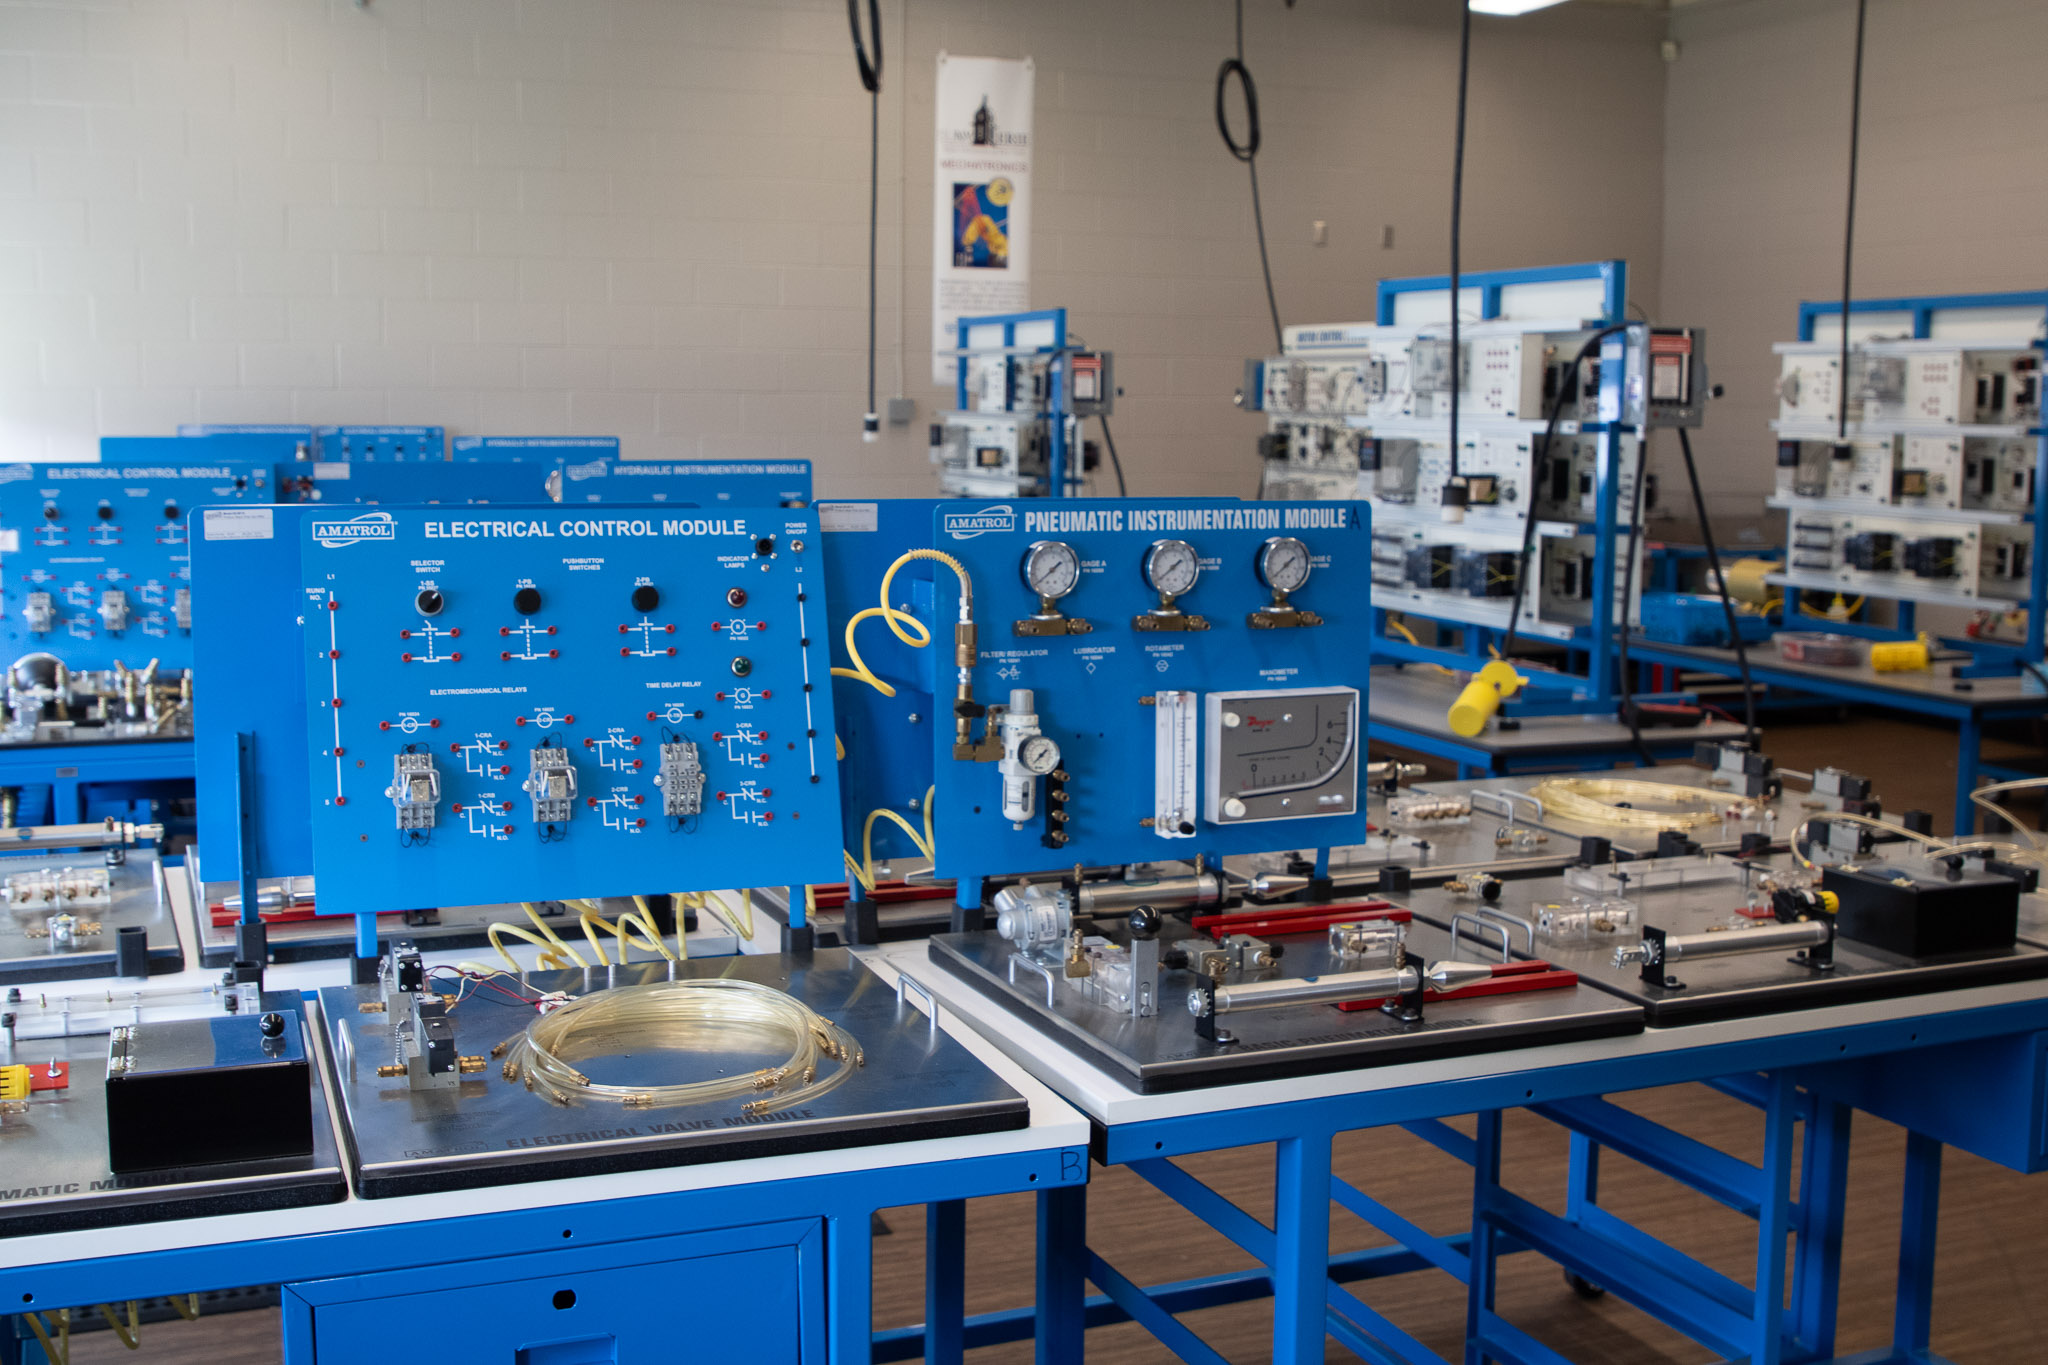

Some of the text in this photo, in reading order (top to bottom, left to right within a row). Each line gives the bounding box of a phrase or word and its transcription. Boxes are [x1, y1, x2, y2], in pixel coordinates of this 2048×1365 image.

[48, 468, 230, 479] ELECTRICAL CONTROL MODULE
[674, 465, 764, 474] INSTRUMENTATION
[766, 464, 806, 474] MODULE
[949, 519, 1011, 529] AMATROL
[1025, 508, 1346, 532] PNEUMATIC INSTRUMENTATION MODULE
[317, 524, 390, 537] AMATROL
[424, 520, 746, 538] ELECTRICAL CONTROL MODULE
[506, 1109, 816, 1148] ELECTRICAL VALVE MODULE
[1060, 1147, 1082, 1181] B
[0, 1183, 79, 1200] MATIC
